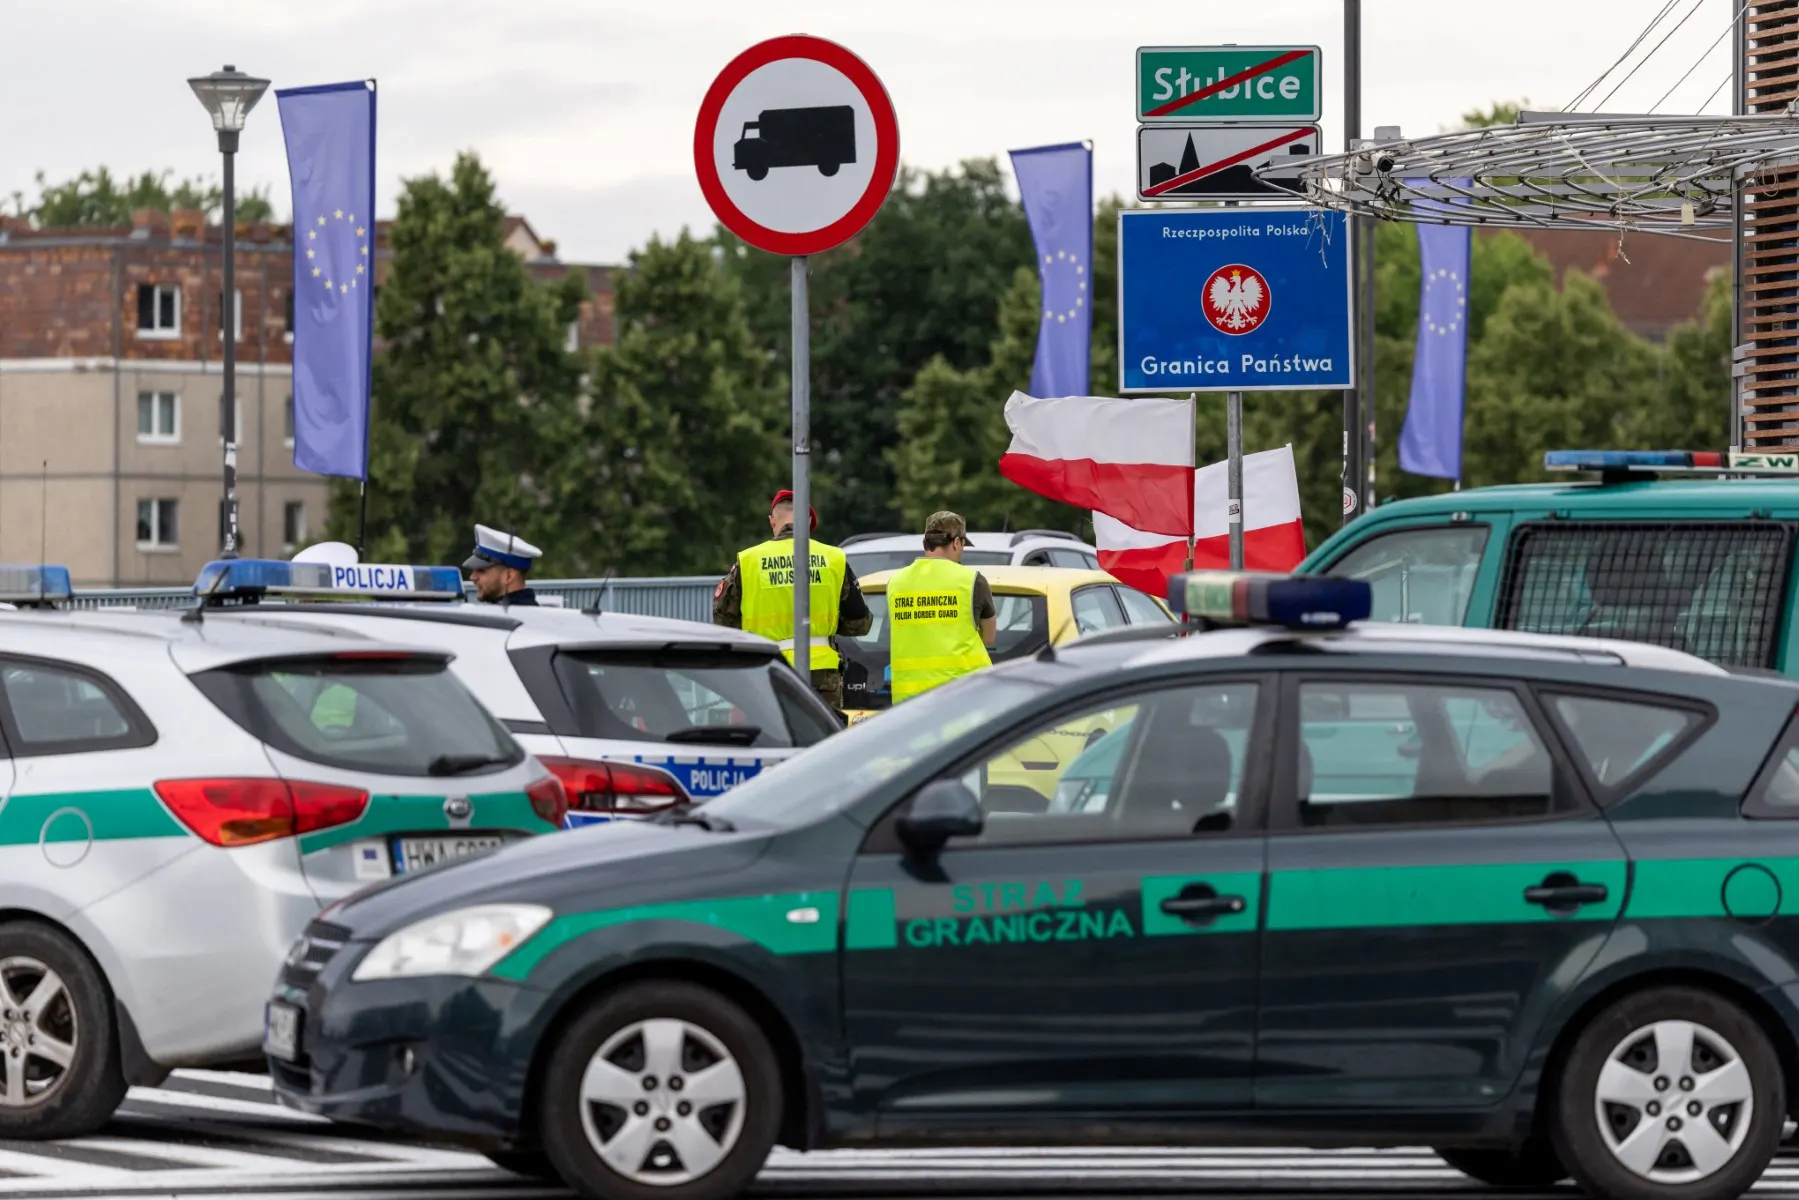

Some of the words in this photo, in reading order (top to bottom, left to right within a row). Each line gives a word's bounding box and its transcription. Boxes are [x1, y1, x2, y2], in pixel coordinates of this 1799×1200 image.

[1152, 66, 1300, 100] Słubice
[1162, 225, 1260, 240] Rzeczpospolita
[1266, 224, 1308, 236] Polska
[1141, 355, 1229, 375] Granica
[1241, 353, 1333, 373] Państwa
[335, 566, 409, 590] POLICJA
[917, 596, 958, 607] GRANICZNA
[894, 611, 912, 621] POLISH
[913, 610, 936, 619] BORDER
[938, 609, 958, 618] GUARD
[904, 909, 1135, 947] GRANICZNA
